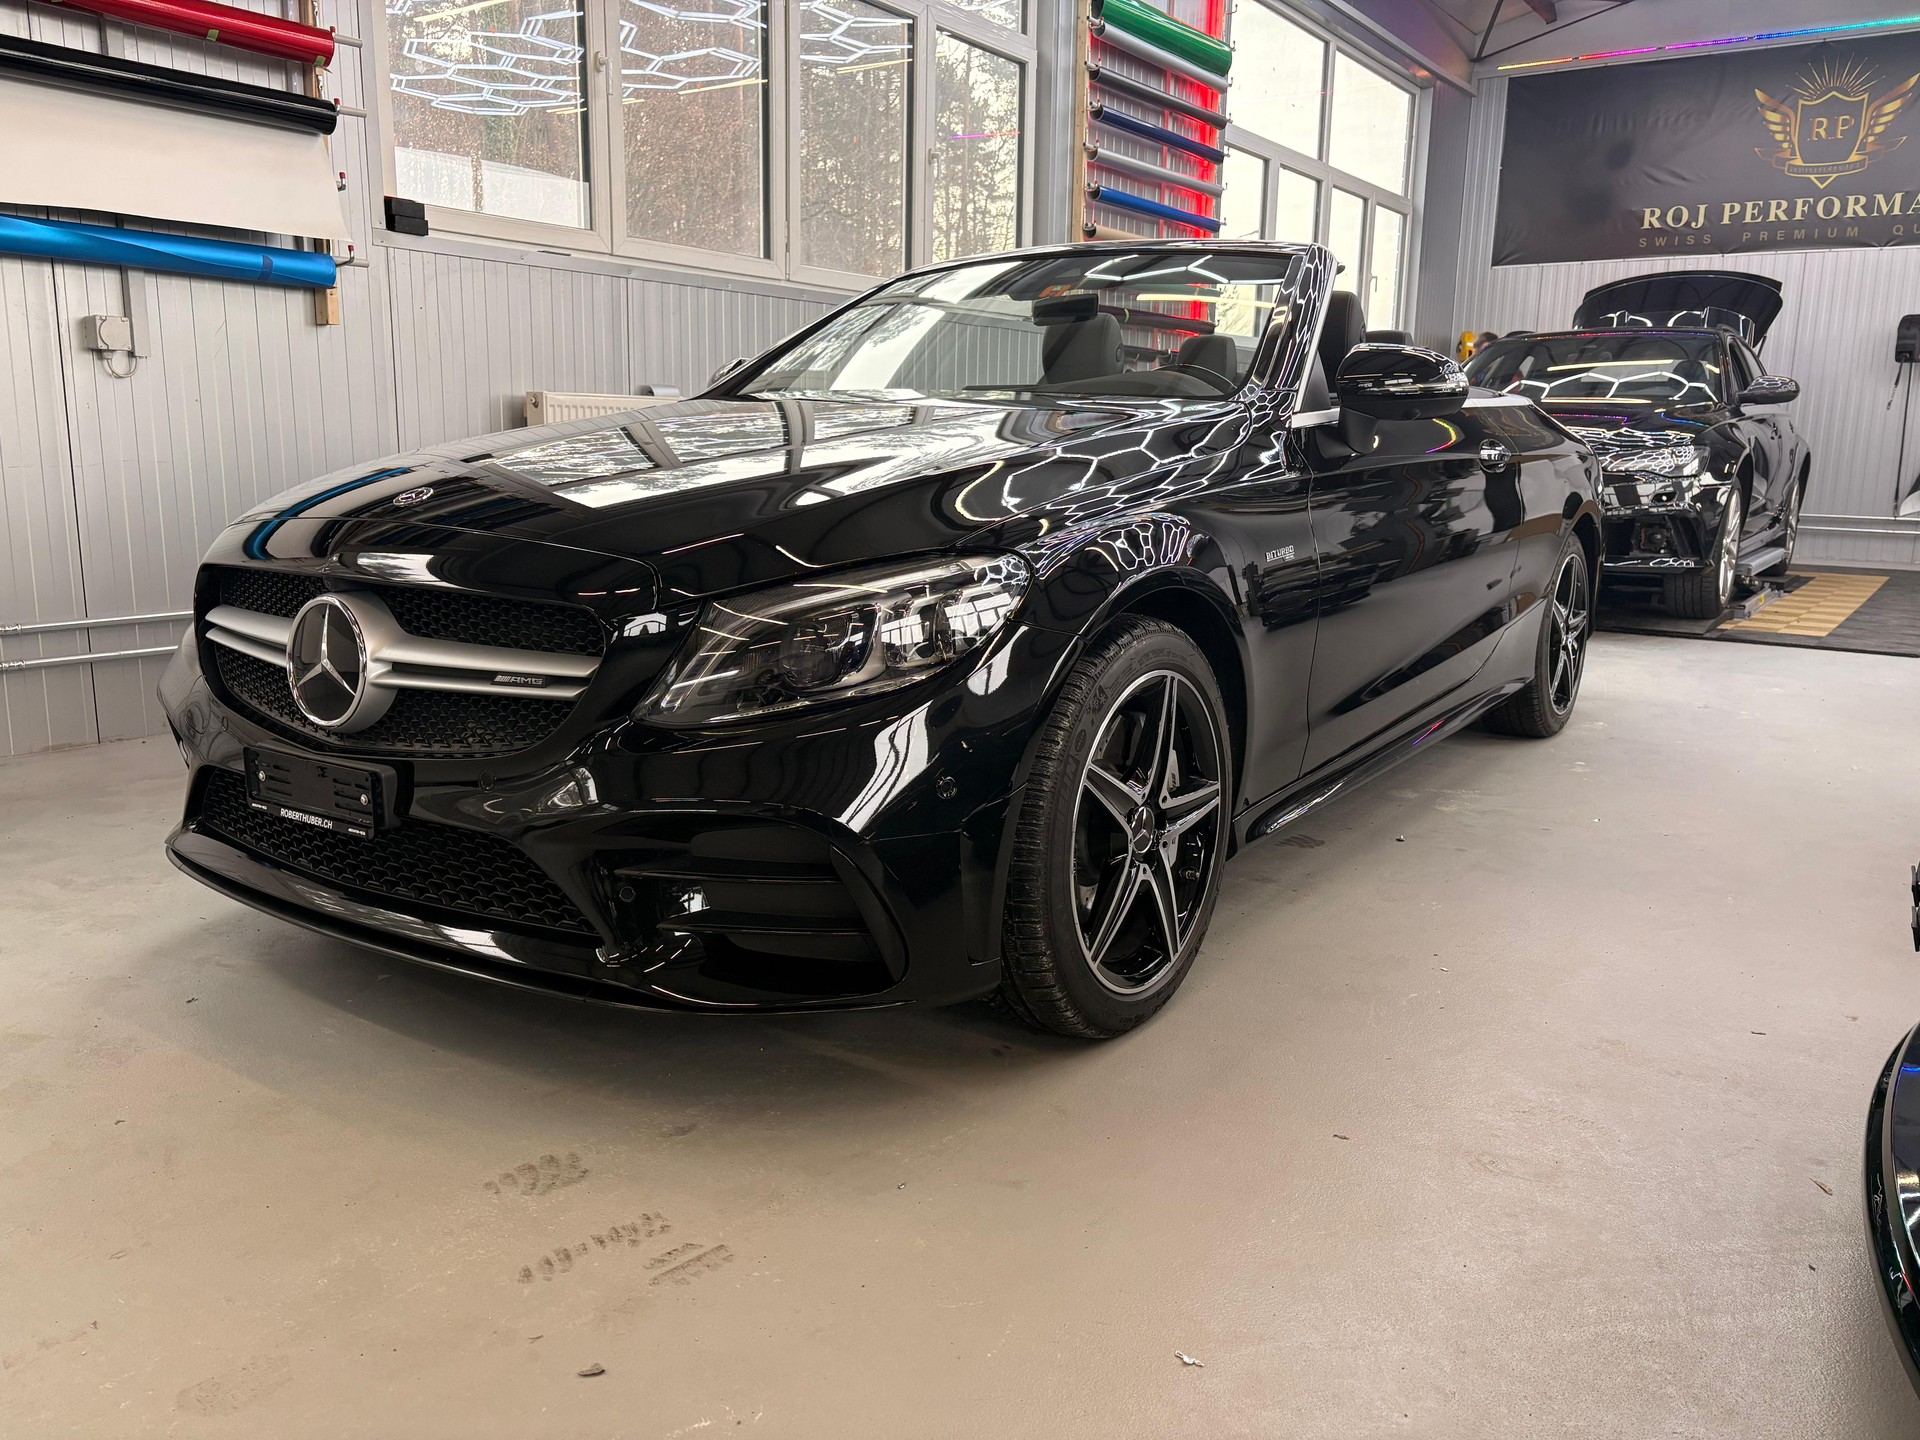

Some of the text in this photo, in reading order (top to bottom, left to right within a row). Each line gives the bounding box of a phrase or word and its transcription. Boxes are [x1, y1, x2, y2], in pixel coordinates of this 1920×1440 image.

[1641, 204, 1708, 229] ROJ
[1639, 234, 1711, 248] SWISS
[1742, 226, 1859, 242] PREMIUM
[1266, 545, 1295, 559] BITURBO
[280, 808, 333, 830] ROBERTHUBER.CH
